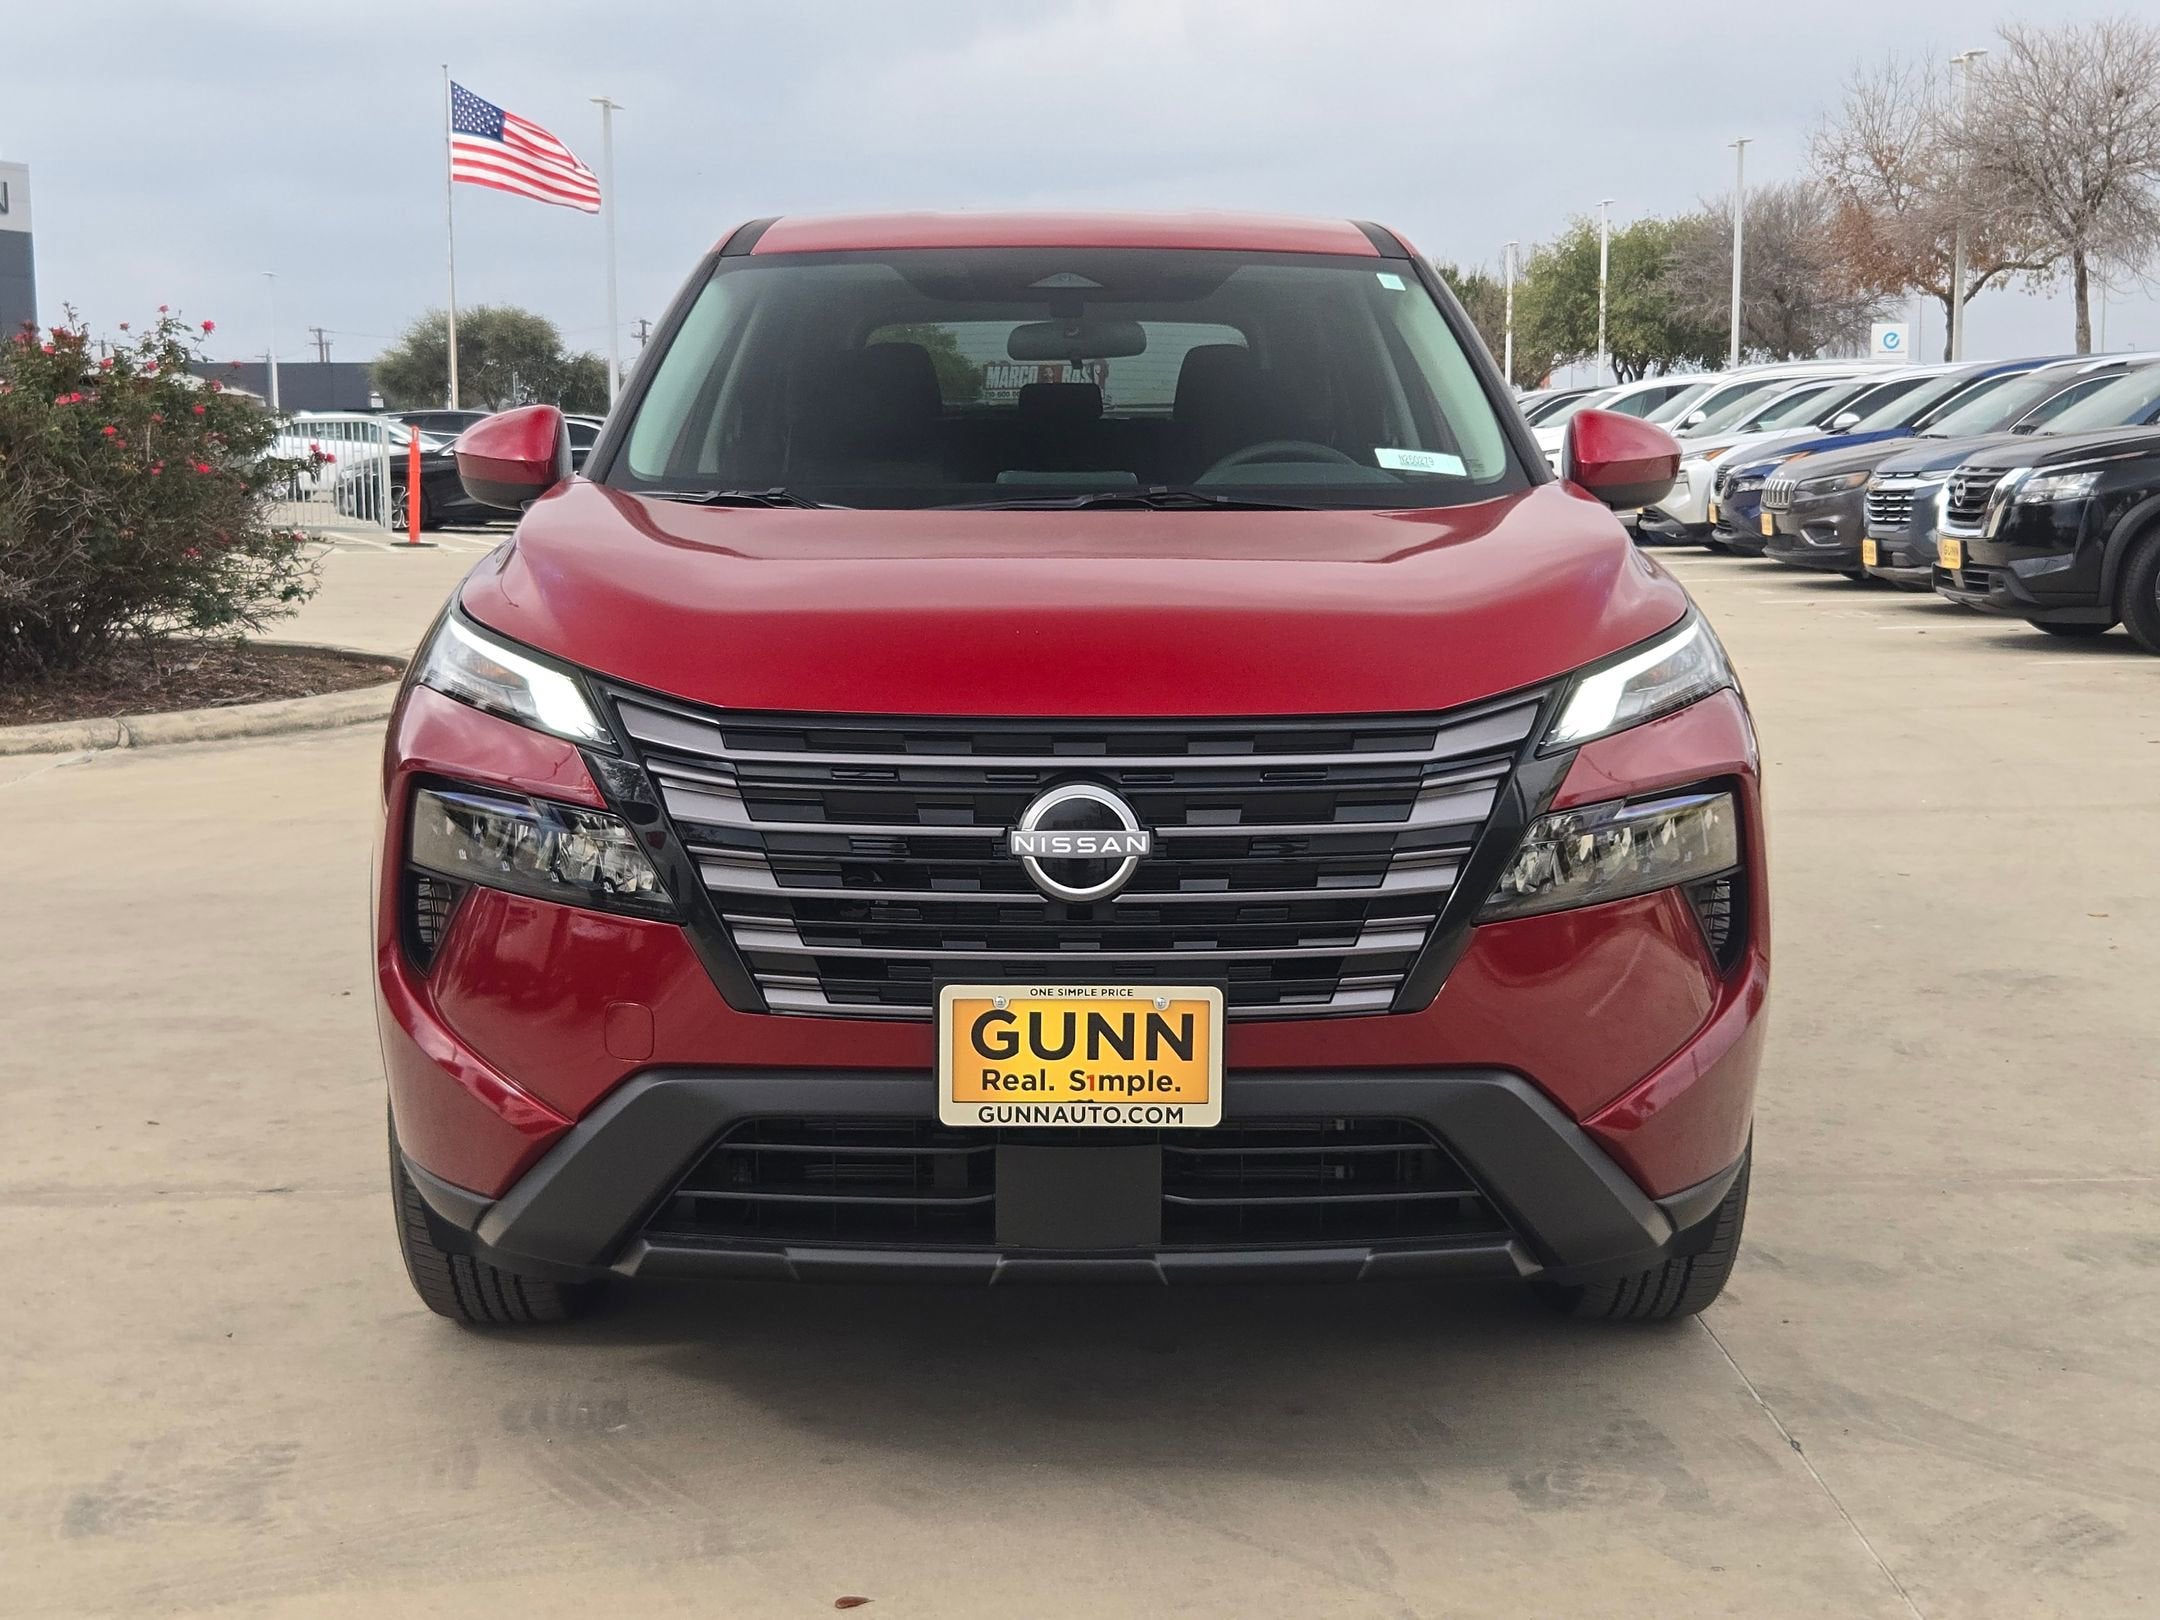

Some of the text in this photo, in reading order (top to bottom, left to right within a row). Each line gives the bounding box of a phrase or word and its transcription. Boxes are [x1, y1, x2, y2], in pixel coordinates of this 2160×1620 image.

[1014, 836, 1147, 853] NISSAN
[1029, 988, 1134, 998] ONE SIMPLE PRICE
[970, 1008, 1194, 1061] GUNN
[981, 1069, 1055, 1091] Real.
[978, 1106, 1184, 1124] GUNNAUTO.COM
